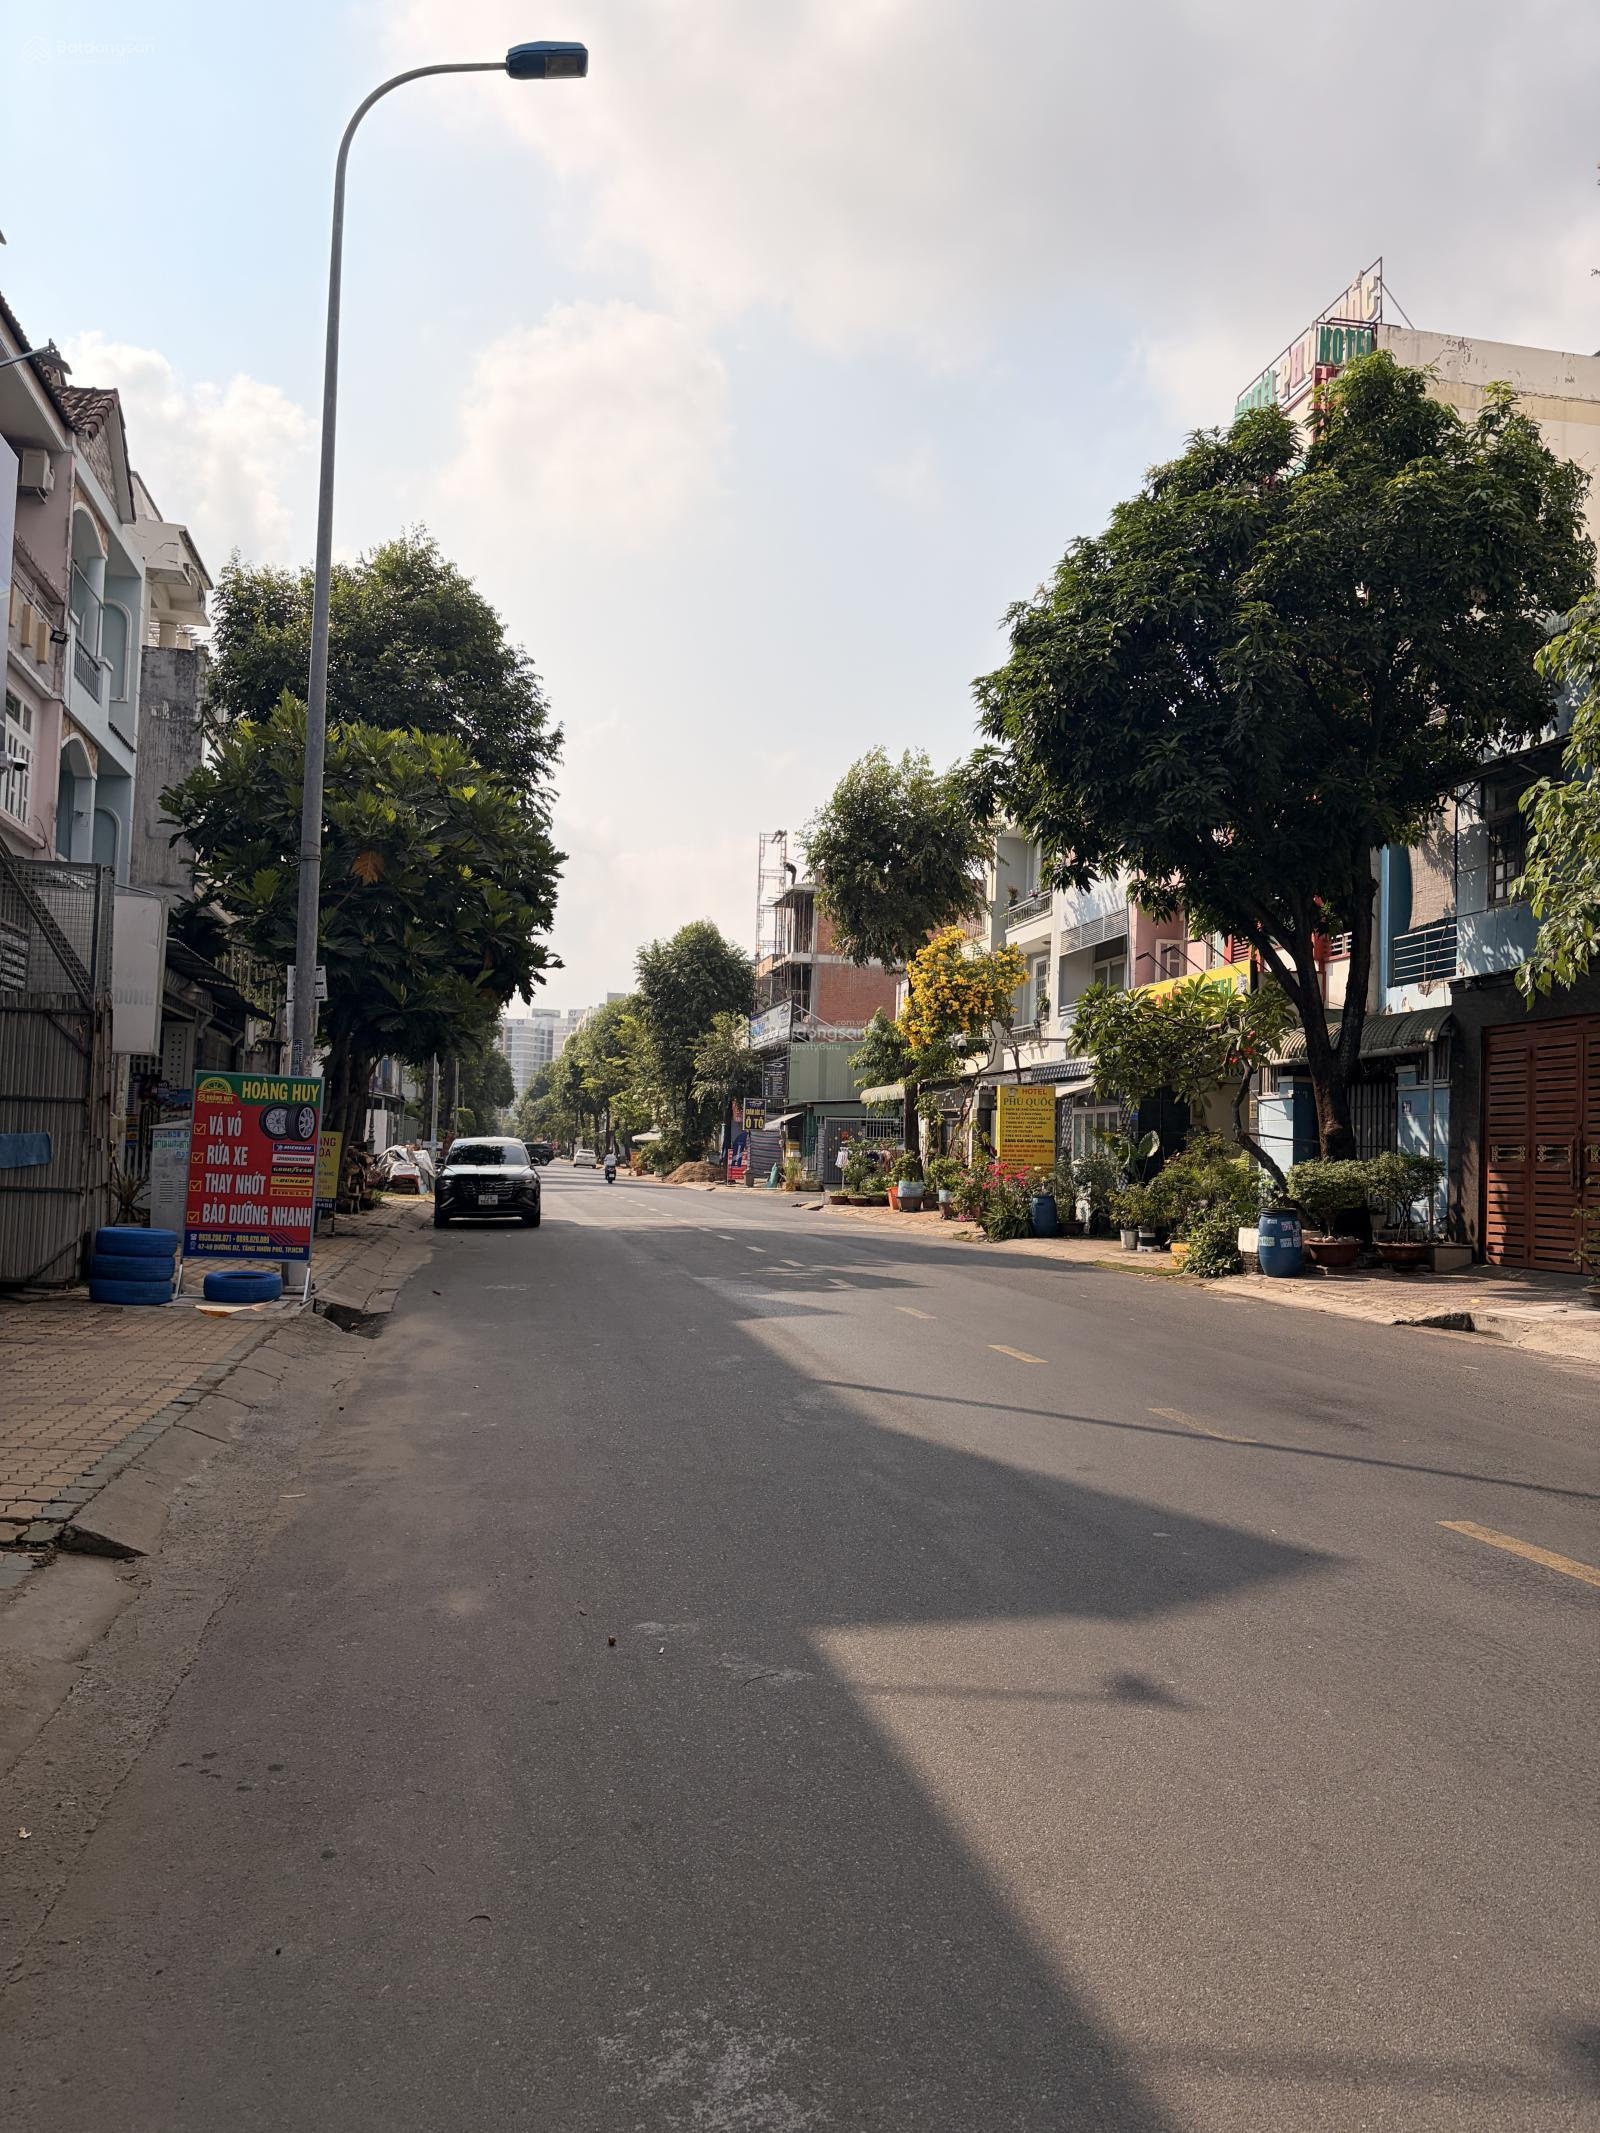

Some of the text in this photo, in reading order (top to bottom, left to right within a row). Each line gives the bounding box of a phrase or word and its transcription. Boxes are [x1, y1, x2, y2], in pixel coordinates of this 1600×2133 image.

[242, 1077, 320, 1103] HOÀNG HUY
[1022, 1088, 1048, 1096] HOTEL
[209, 1110, 242, 1137] VÁ VỎ
[207, 1138, 230, 1166] RỬA
[233, 1146, 249, 1167] XE
[205, 1171, 267, 1196] THAY NHỚT
[202, 1197, 312, 1227] BẢO DƯỠNG NHANH
